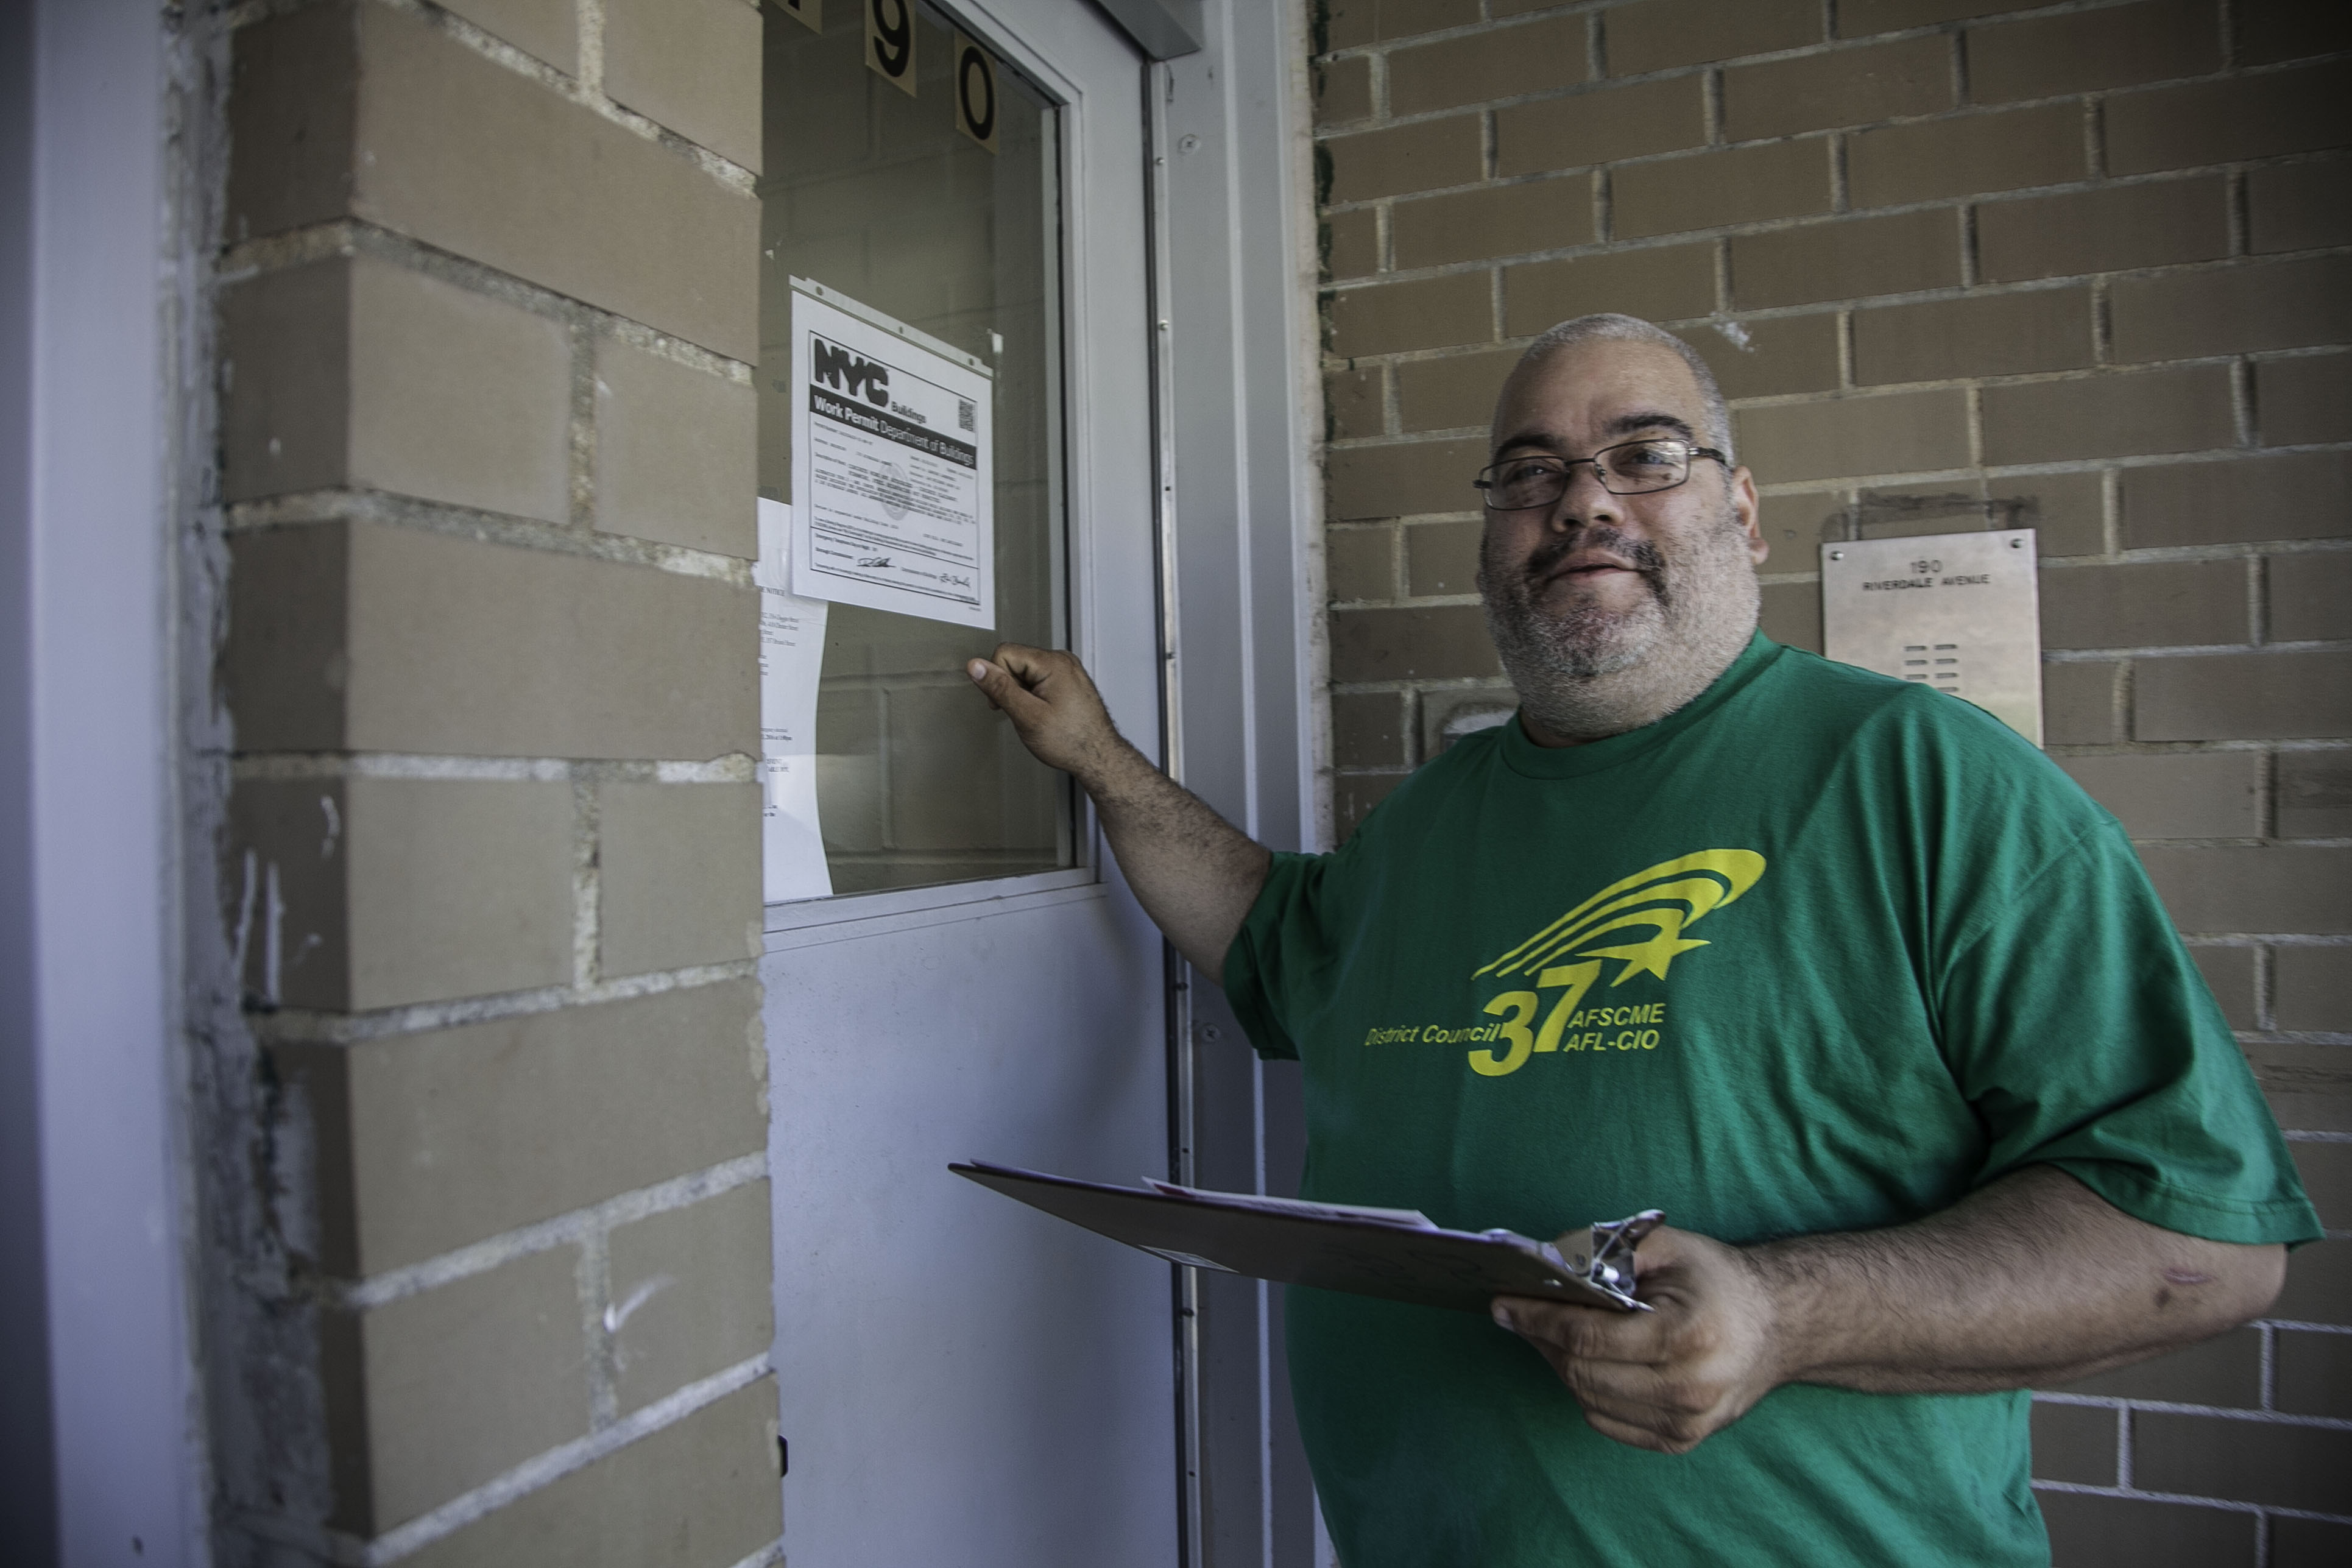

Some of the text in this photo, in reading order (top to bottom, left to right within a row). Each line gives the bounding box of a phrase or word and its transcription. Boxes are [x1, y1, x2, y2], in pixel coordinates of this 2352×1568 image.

[814, 339, 888, 408] NYC
[891, 401, 927, 425] Buildings
[814, 394, 843, 420] Work
[845, 409, 879, 432] Permit
[880, 420, 929, 450] Department
[930, 436, 940, 451] of
[940, 439, 974, 466] Buildings
[1910, 559, 1943, 574] 190
[1862, 574, 1991, 591] RIVERDALE AVENUE
[1365, 959, 1601, 1076] District Council 37
[1567, 1003, 1666, 1028] AFSCME
[1563, 1029, 1660, 1052] AFL-CIO
